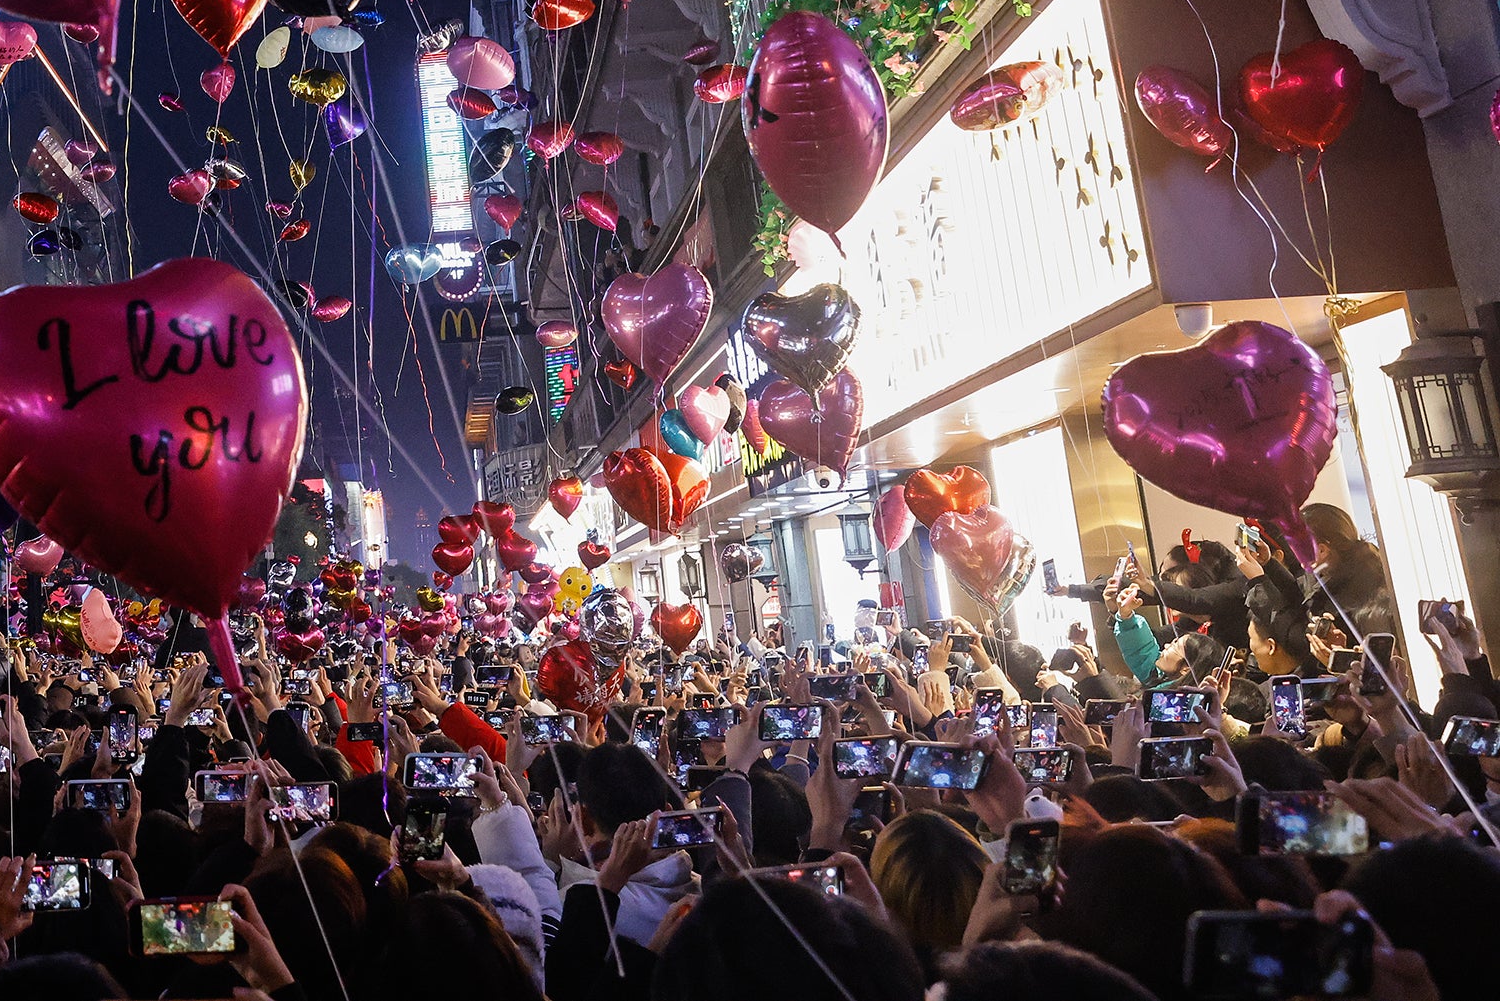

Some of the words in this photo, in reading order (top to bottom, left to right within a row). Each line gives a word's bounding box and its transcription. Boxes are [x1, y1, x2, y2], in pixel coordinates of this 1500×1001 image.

[37, 318, 119, 410] I
[126, 300, 274, 382] love
[130, 406, 263, 524] you
